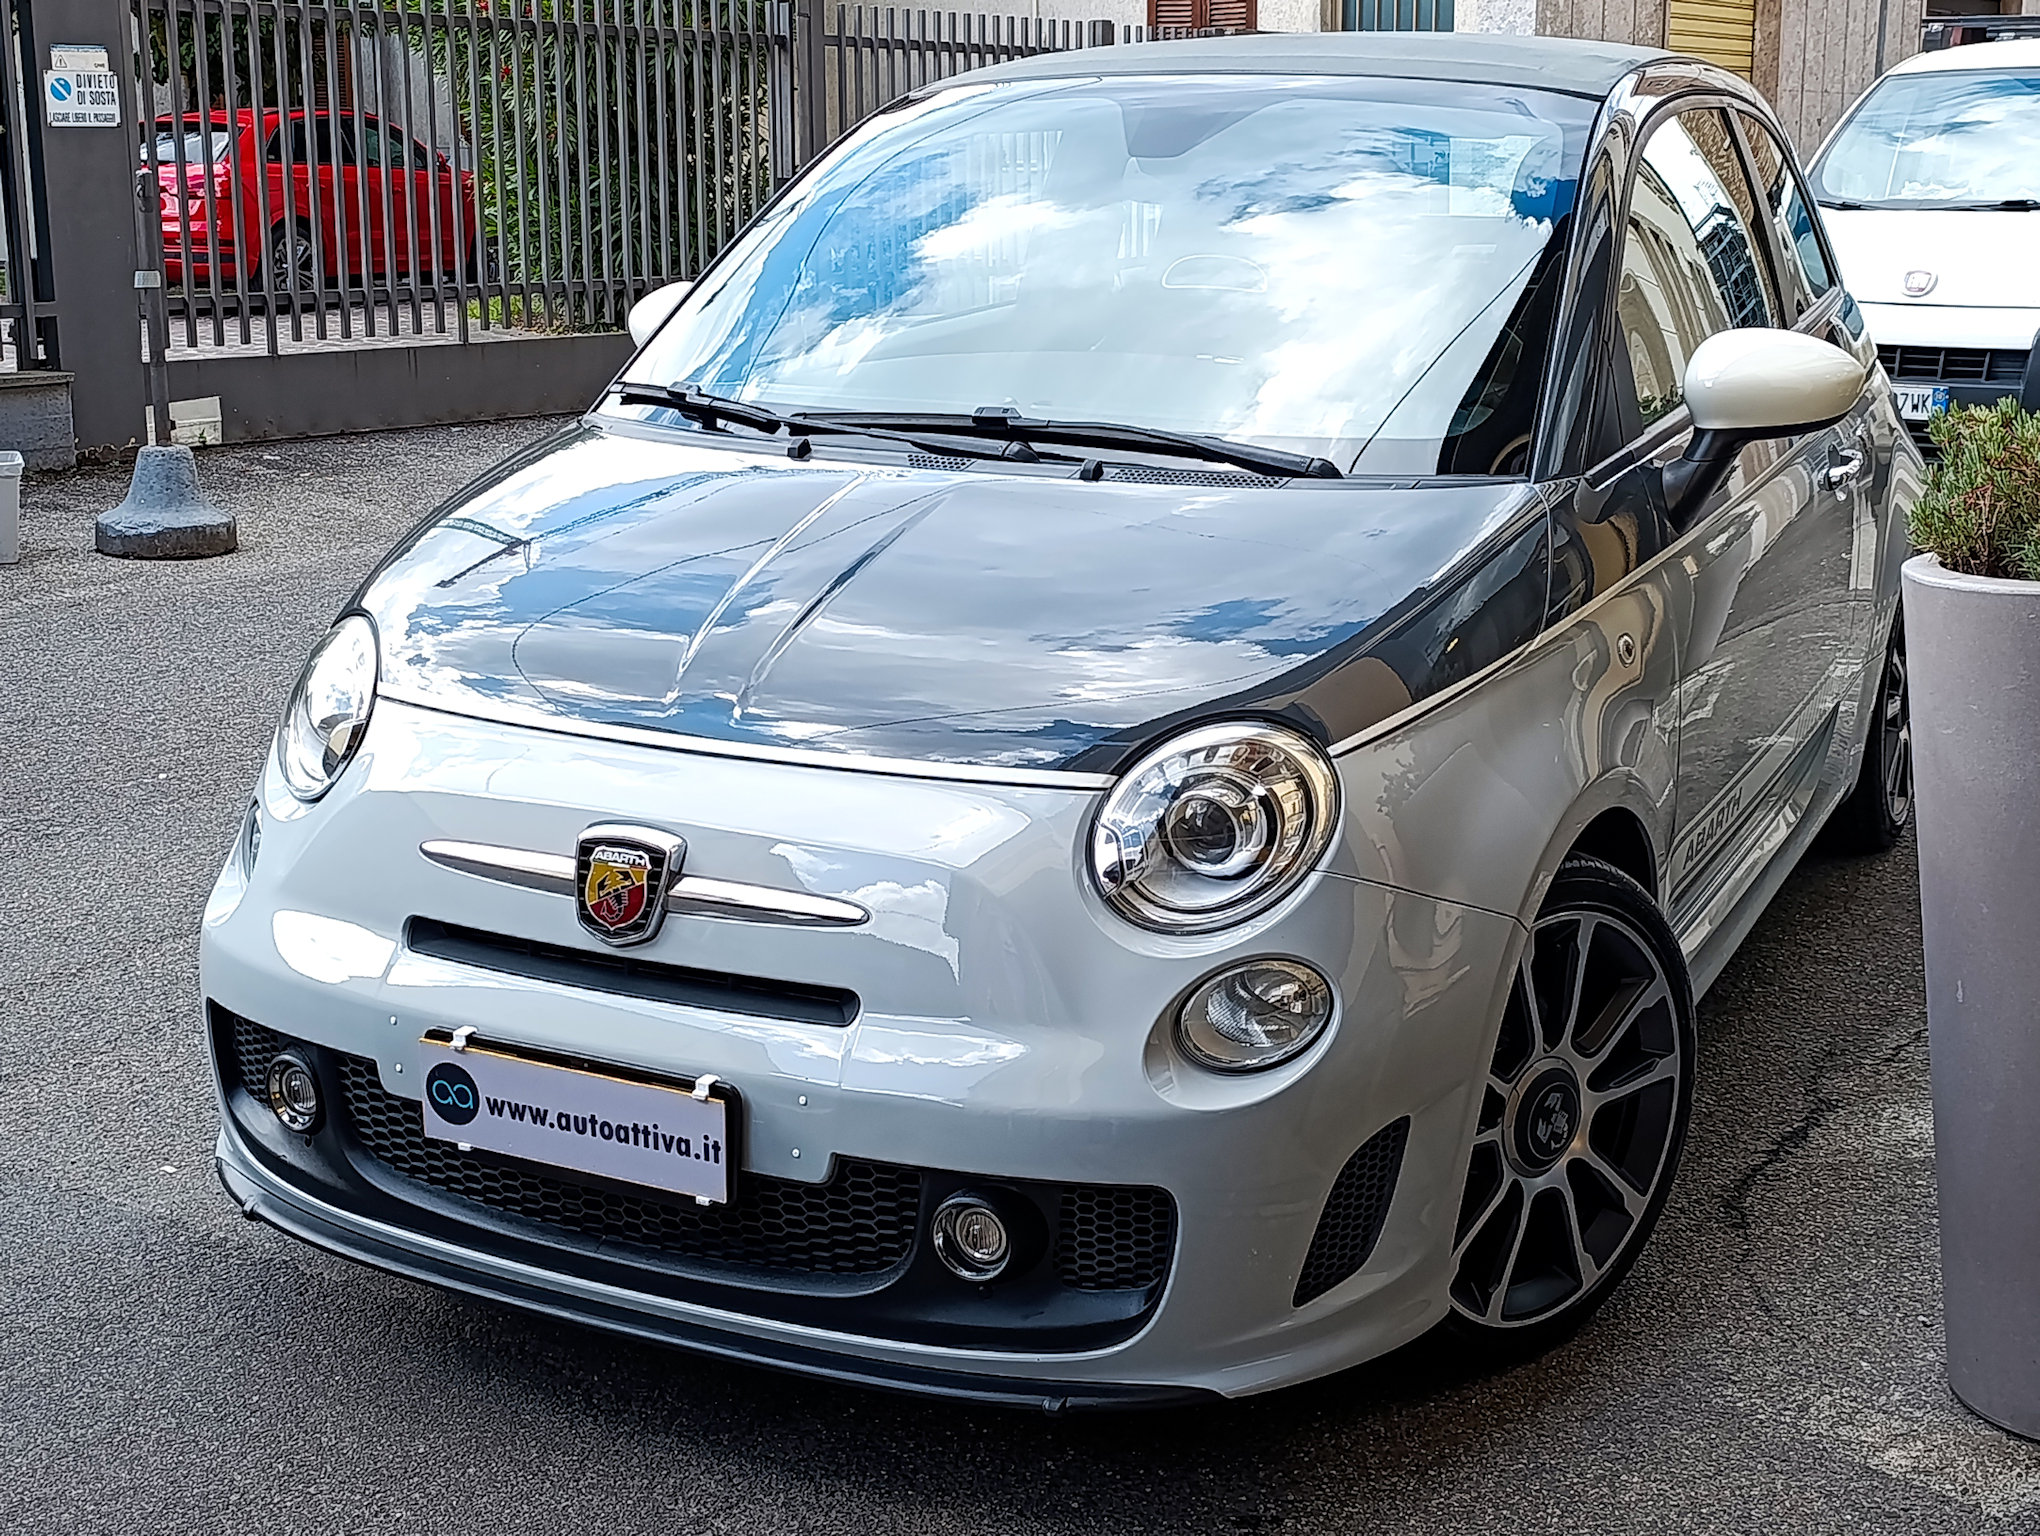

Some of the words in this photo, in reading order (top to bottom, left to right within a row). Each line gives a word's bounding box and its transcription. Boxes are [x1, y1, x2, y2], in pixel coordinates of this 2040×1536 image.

[76, 73, 115, 89] DIVIETO
[77, 91, 86, 105] DI
[89, 91, 117, 106] SOSTA
[1683, 786, 1743, 870] ABARTH
[595, 851, 646, 866] ABARTH
[485, 1096, 722, 1164] www.autoattiva.it
